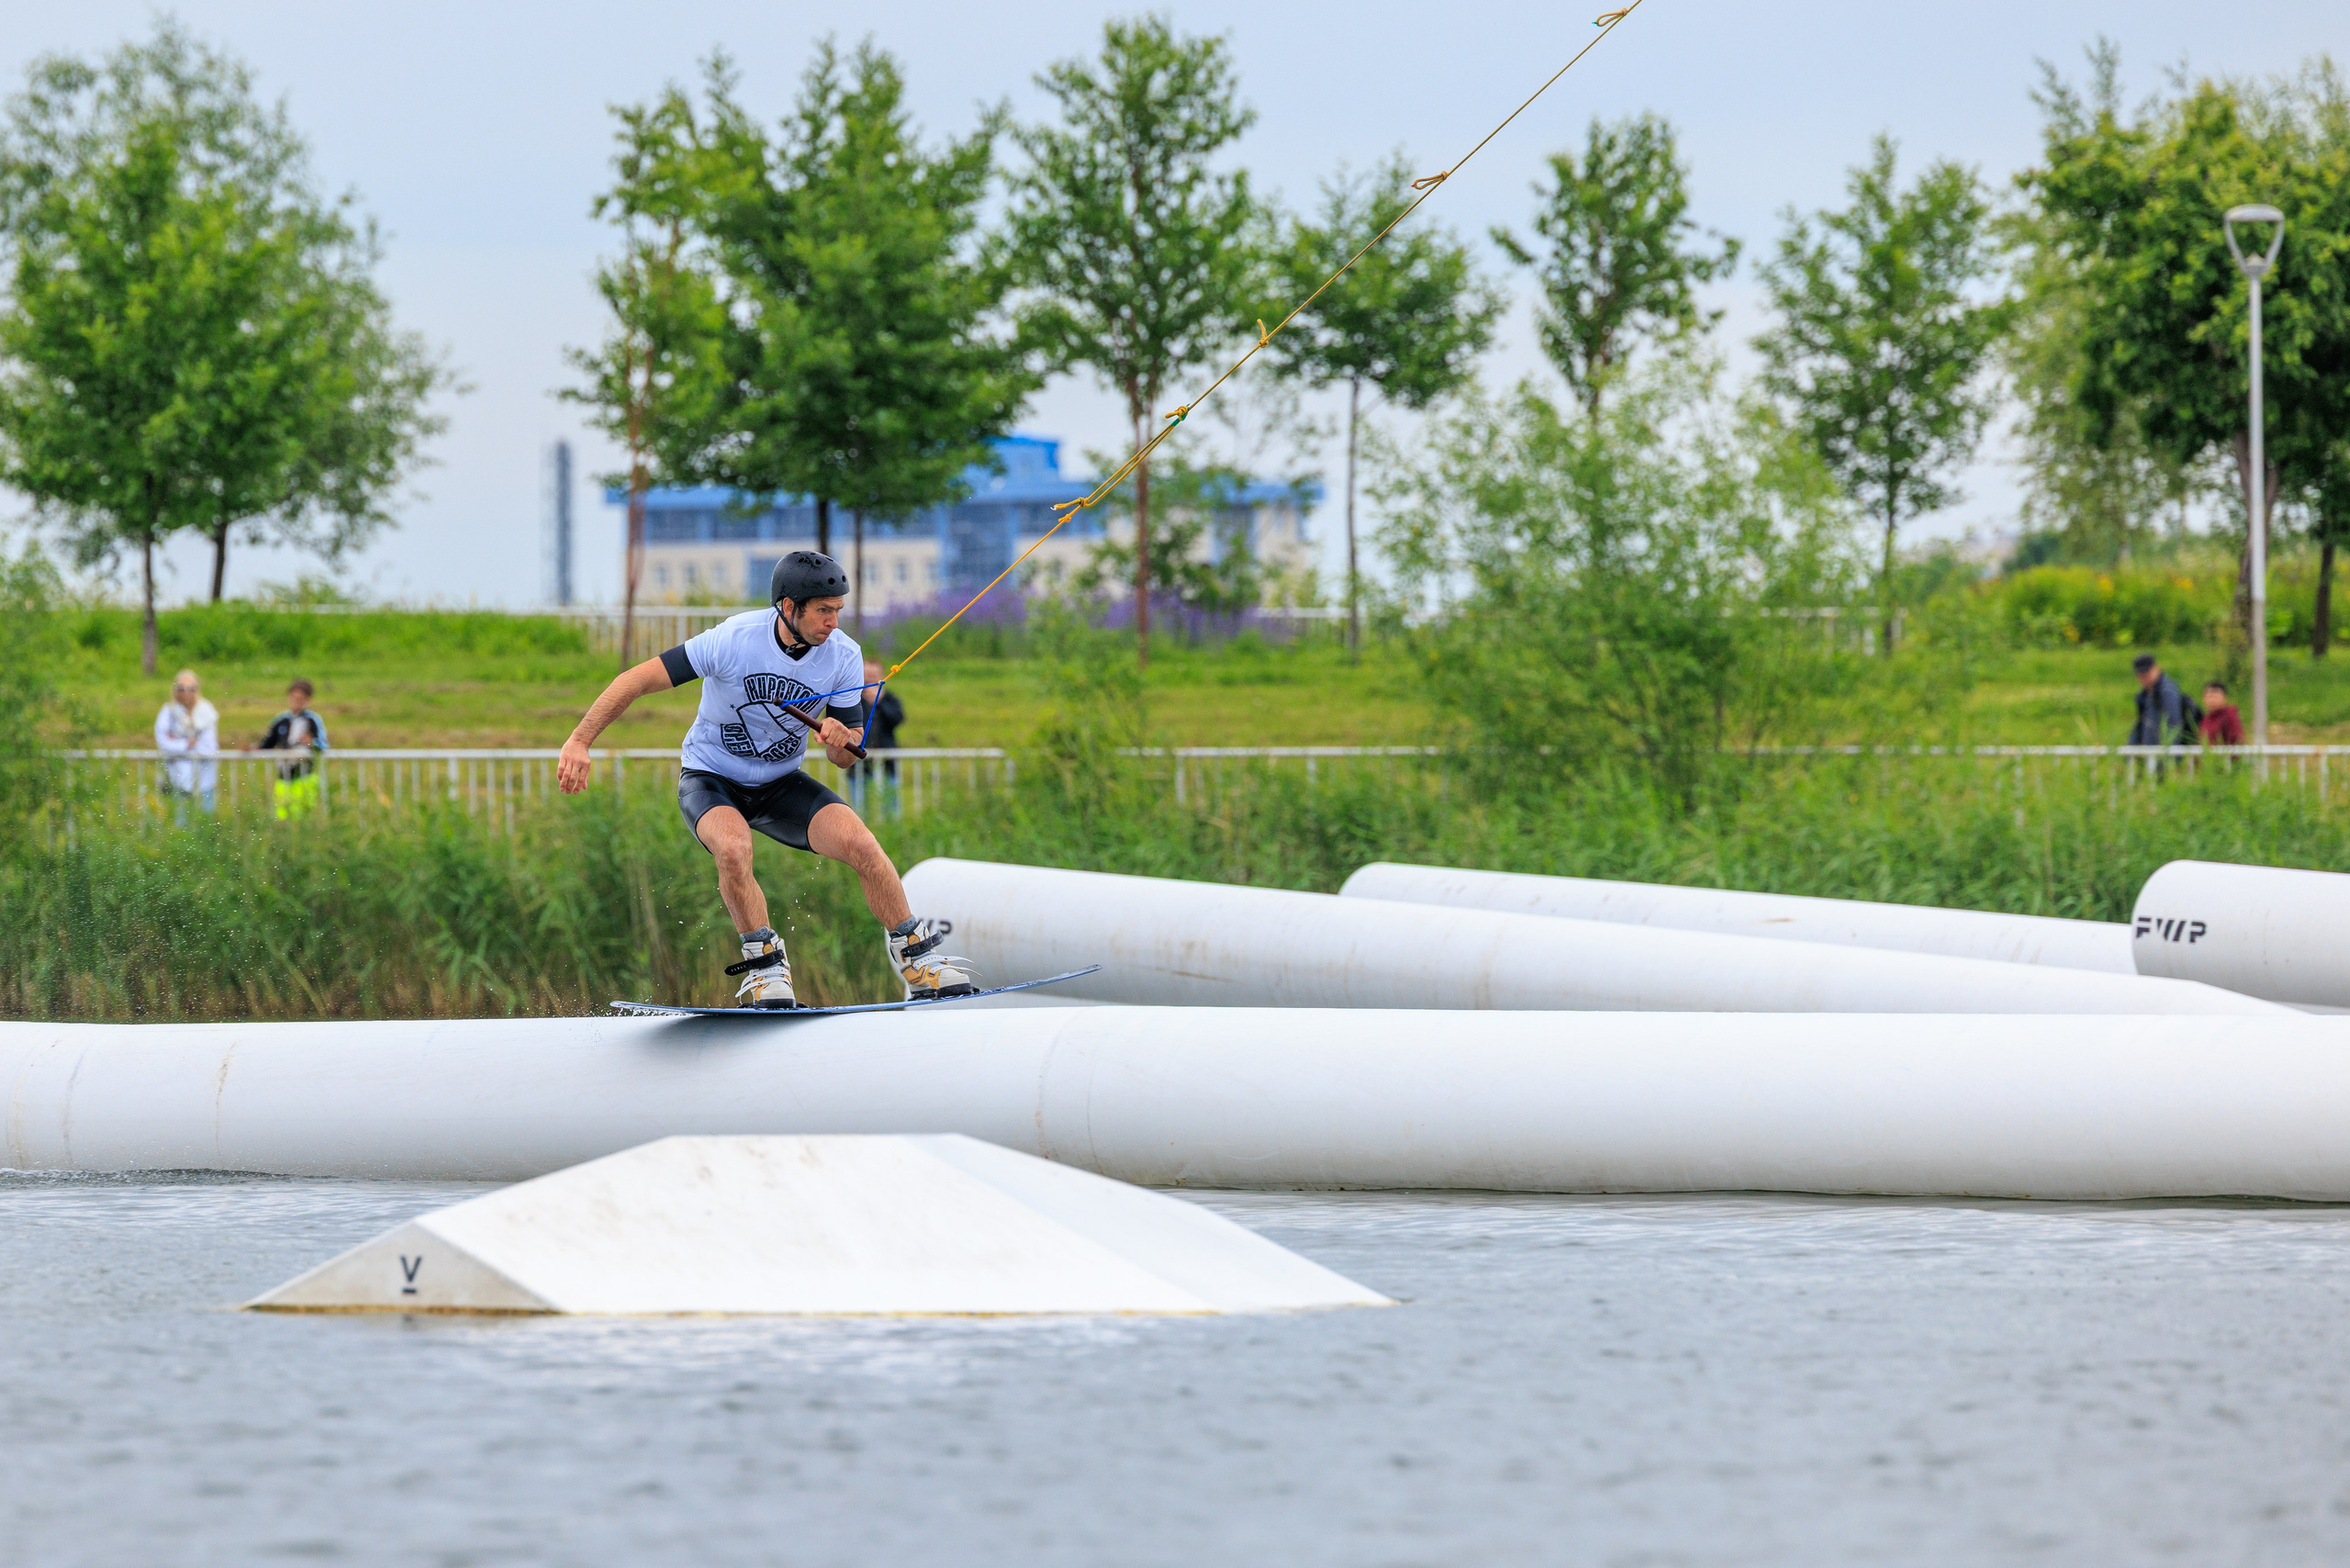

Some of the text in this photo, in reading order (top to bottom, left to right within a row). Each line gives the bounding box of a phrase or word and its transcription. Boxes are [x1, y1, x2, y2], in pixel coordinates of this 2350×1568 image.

[723, 723, 755, 756] OPEN
[761, 735, 800, 762] 2023
[2135, 916, 2207, 944] FWP
